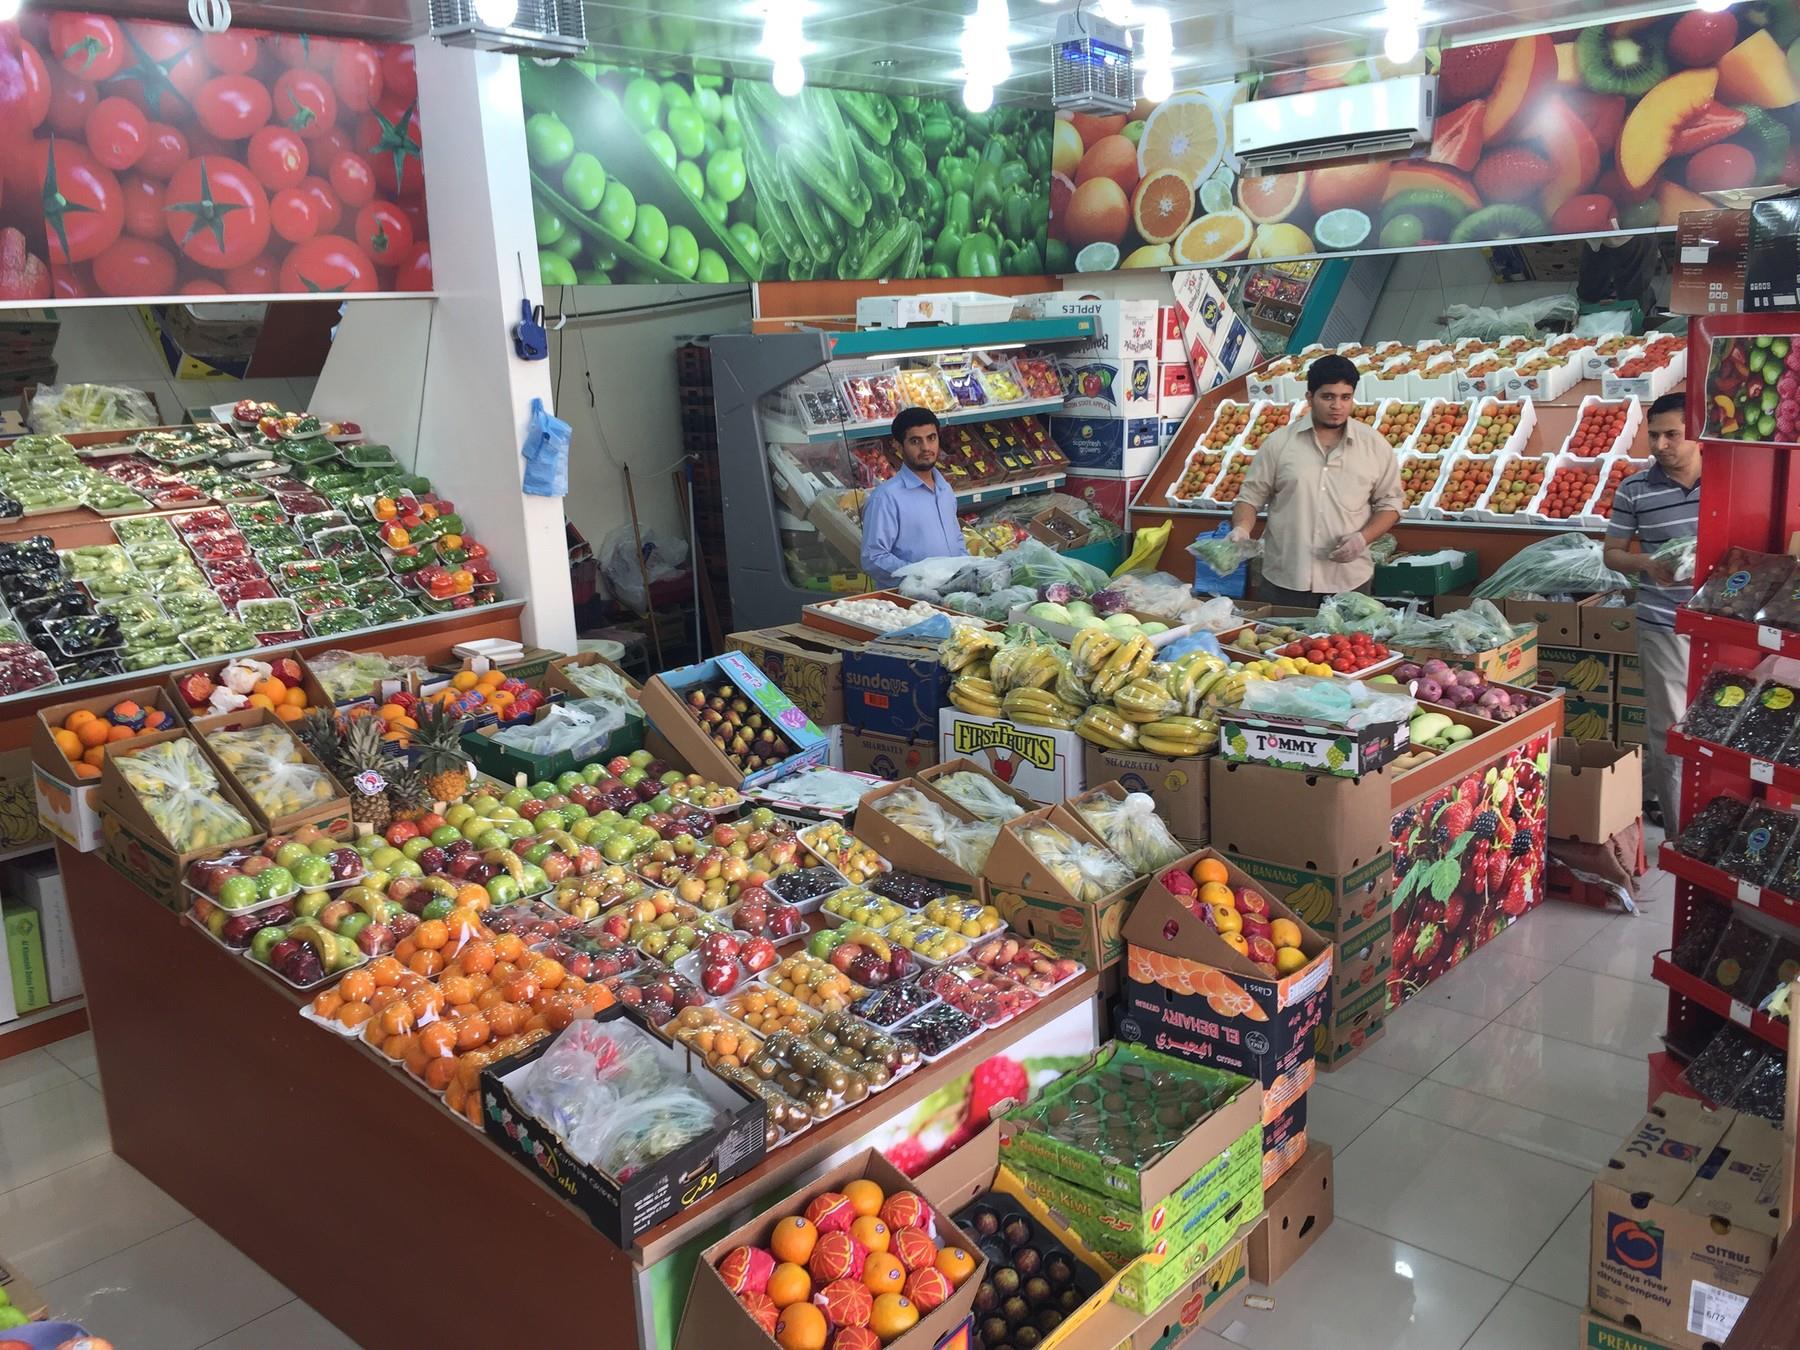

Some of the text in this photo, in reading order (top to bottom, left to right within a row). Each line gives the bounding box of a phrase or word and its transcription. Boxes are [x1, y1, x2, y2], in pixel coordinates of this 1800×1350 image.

[1062, 304, 1102, 314] APPLES
[1072, 440, 1101, 449] superfresh
[846, 672, 909, 696] sundays
[958, 724, 1051, 766] FIRST FRUITS
[1256, 733, 1318, 755] TOMMY
[1105, 757, 1161, 772] SHARBATLY
[1253, 864, 1299, 884] BANANAS
[1251, 984, 1272, 997] Class
[1161, 1008, 1220, 1039] BEHAIRY
[1221, 1026, 1240, 1045] EL
[1626, 1123, 1666, 1158] SRCC
[1060, 1190, 1093, 1218] Kiwi
[1705, 1244, 1752, 1265] CITRUS
[1600, 1261, 1669, 1293] sundays river
[1597, 1270, 1622, 1288] citrus
[1624, 1283, 1672, 1307] company
